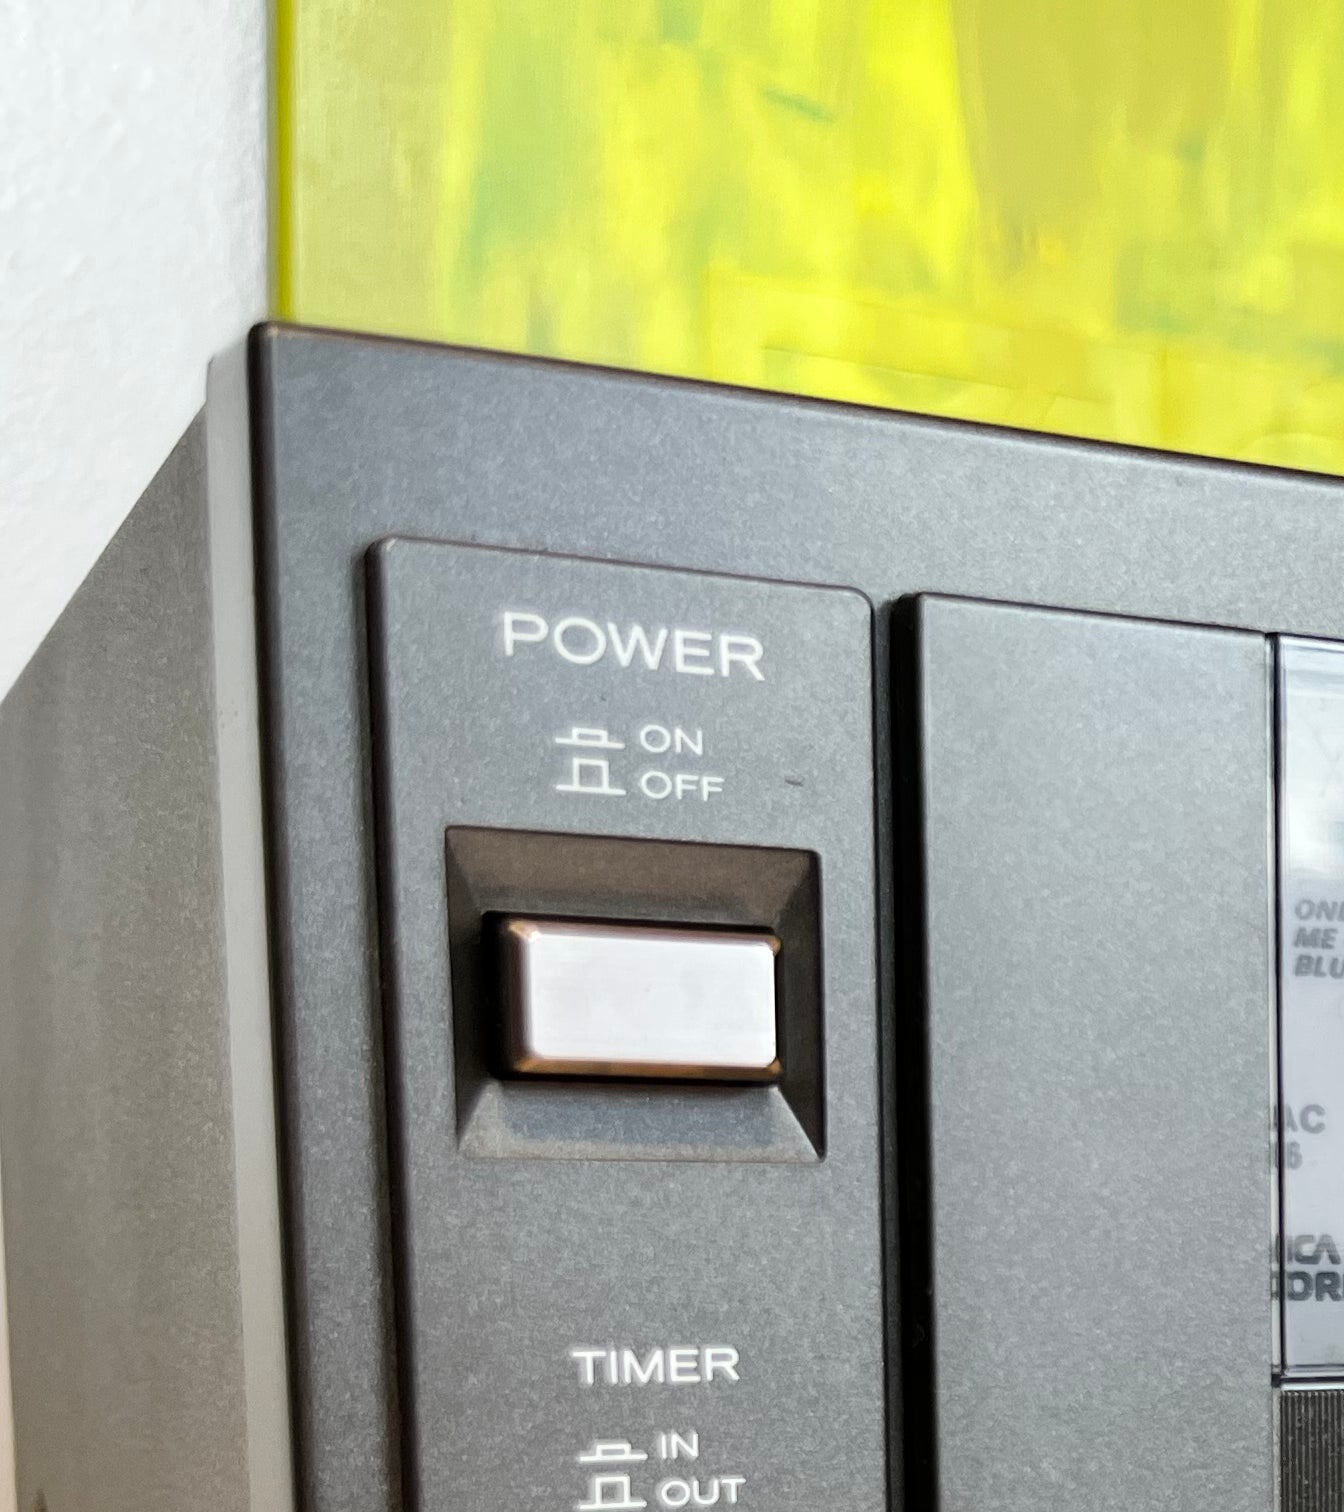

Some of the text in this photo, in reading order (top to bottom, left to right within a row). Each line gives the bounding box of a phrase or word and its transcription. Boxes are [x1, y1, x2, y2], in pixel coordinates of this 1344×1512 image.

[503, 610, 766, 682] POWER
[639, 723, 704, 756] ON
[640, 770, 726, 803] OFF
[1293, 926, 1339, 950] ME
[571, 1347, 741, 1386] TIMER
[658, 1430, 699, 1460] IN
[660, 1475, 748, 1507] OUT
